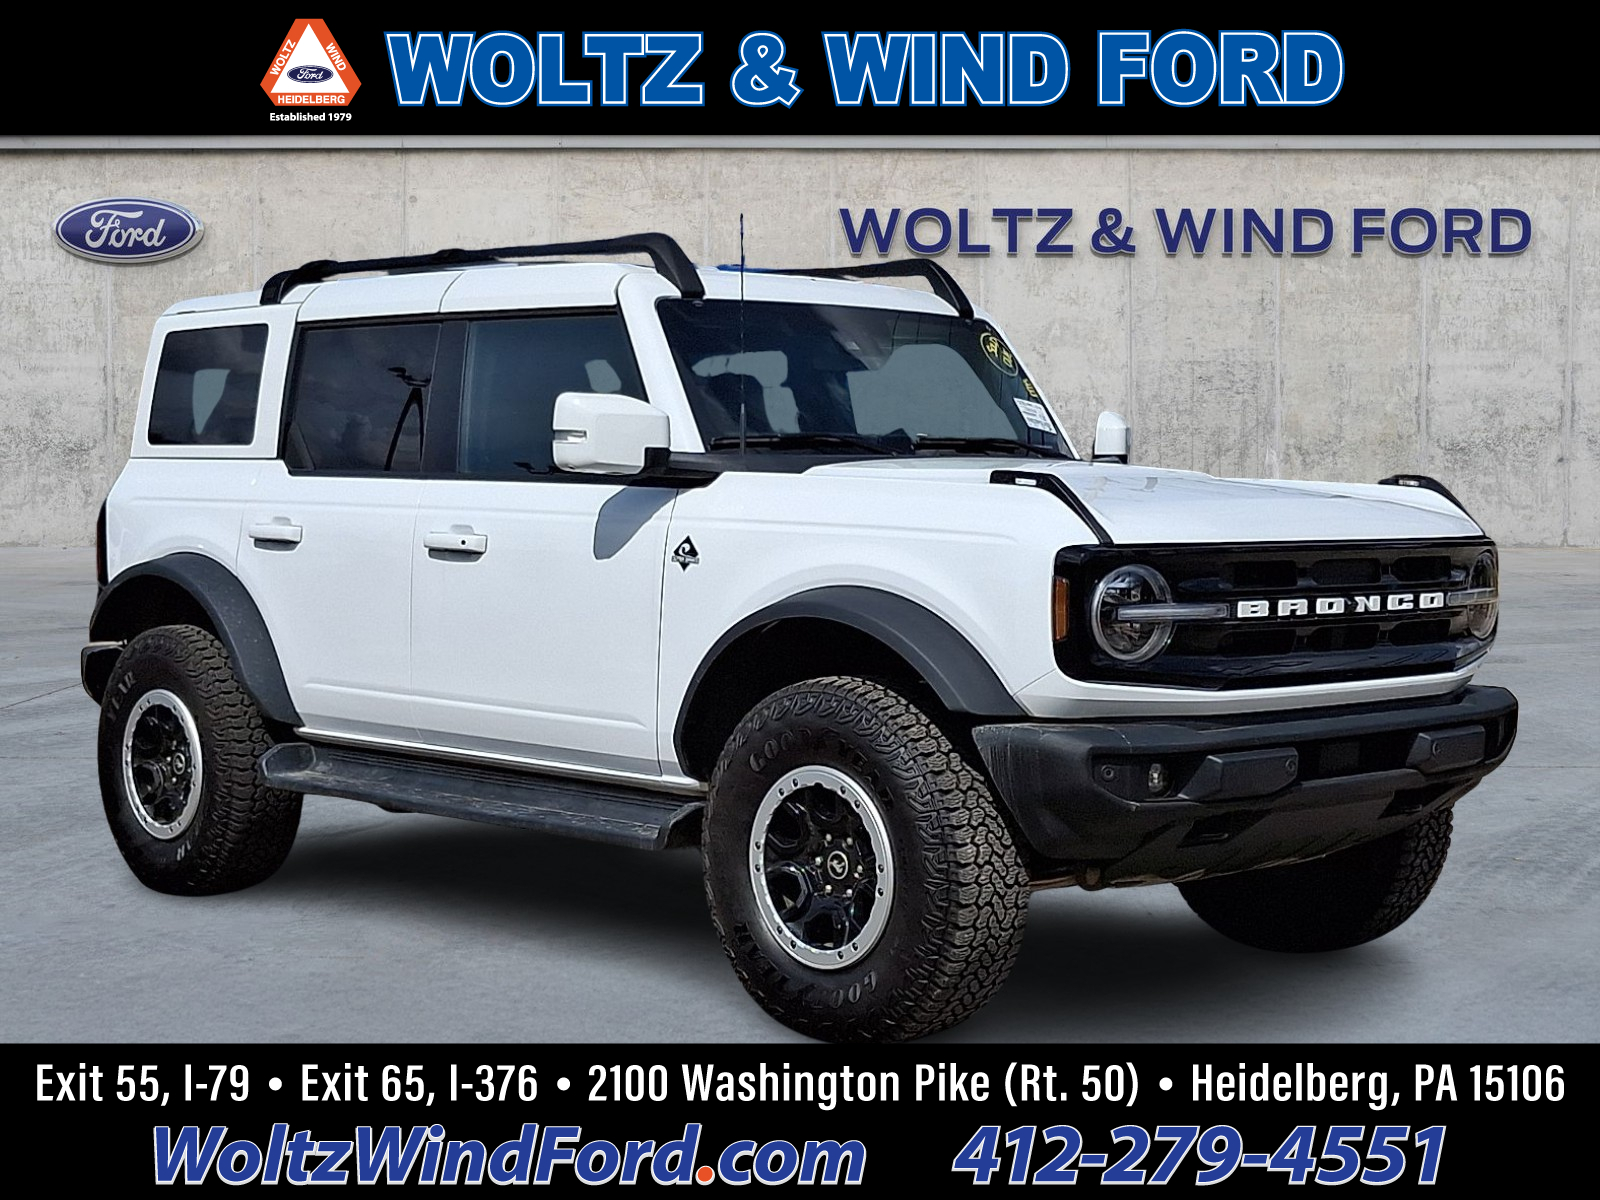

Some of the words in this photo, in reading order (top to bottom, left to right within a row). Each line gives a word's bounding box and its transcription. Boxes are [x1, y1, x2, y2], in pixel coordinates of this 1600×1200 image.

[85, 209, 166, 249] Ford
[840, 208, 1073, 254] WOLTZ
[1092, 207, 1136, 254] &
[1156, 208, 1333, 253] WIND
[1353, 207, 1532, 254] FORD
[1237, 592, 1444, 618] BRONCO
